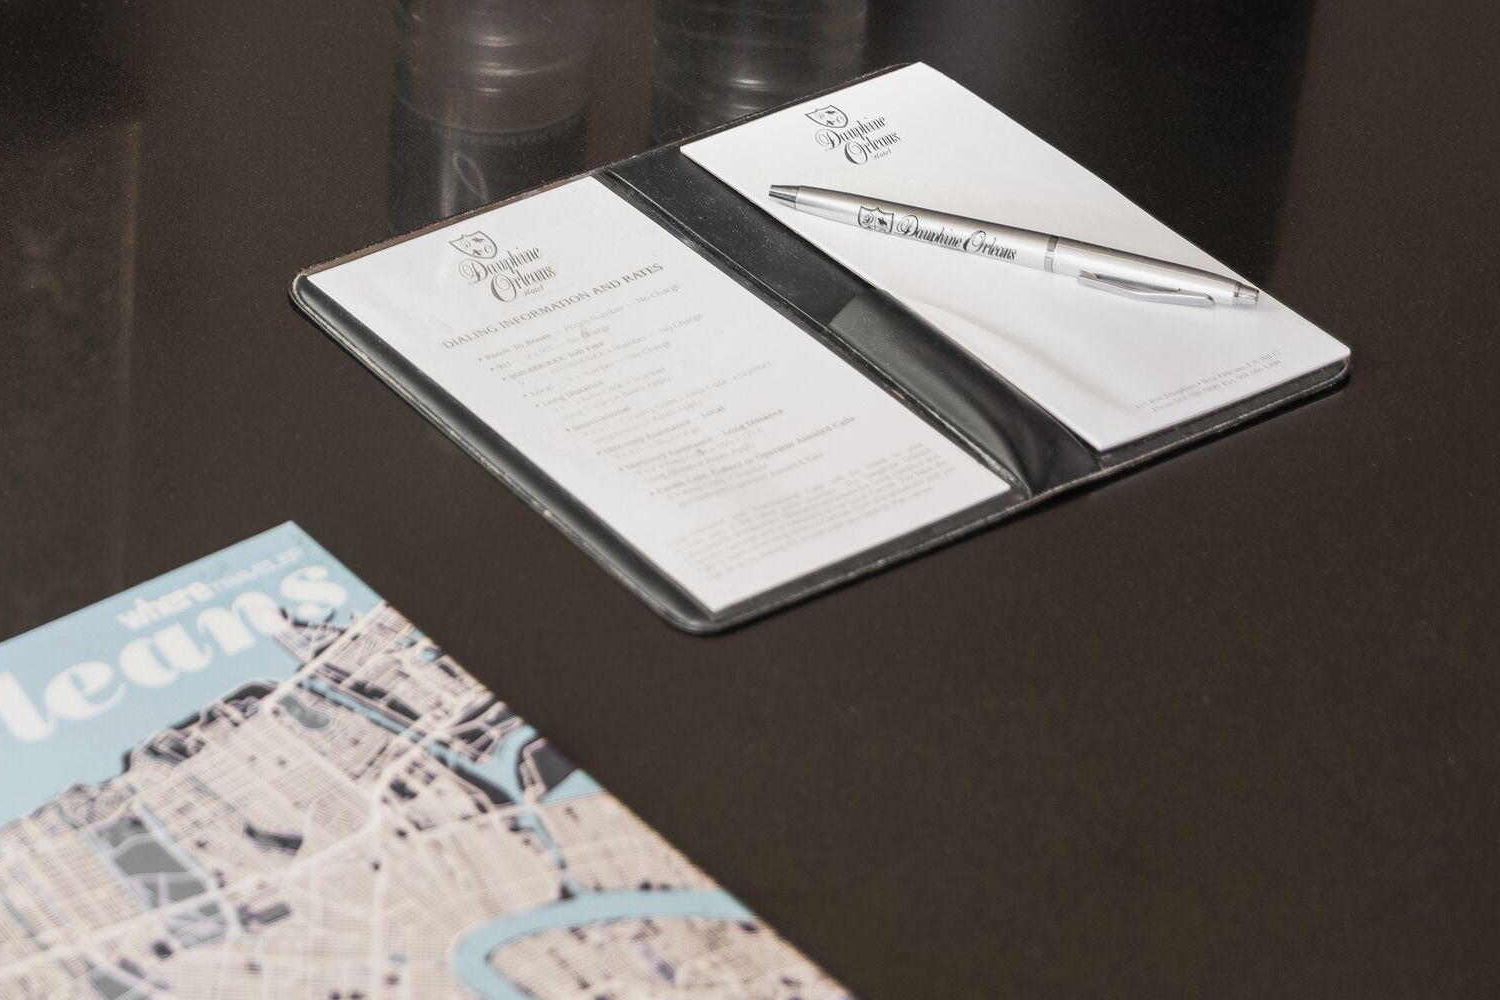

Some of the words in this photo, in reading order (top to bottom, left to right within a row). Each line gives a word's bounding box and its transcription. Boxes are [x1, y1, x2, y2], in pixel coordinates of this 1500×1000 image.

[814, 116, 888, 152] Dauphine
[844, 132, 902, 165] Orleans
[896, 214, 963, 248] Dauphine
[962, 230, 1017, 260] Orleans
[458, 246, 542, 286] Dauphine
[491, 265, 557, 303] Orleans
[443, 325, 498, 348] DIALING
[500, 292, 590, 328] INFORMATION
[591, 280, 620, 295] AND
[623, 264, 663, 283] RATES
[116, 581, 215, 631] where
